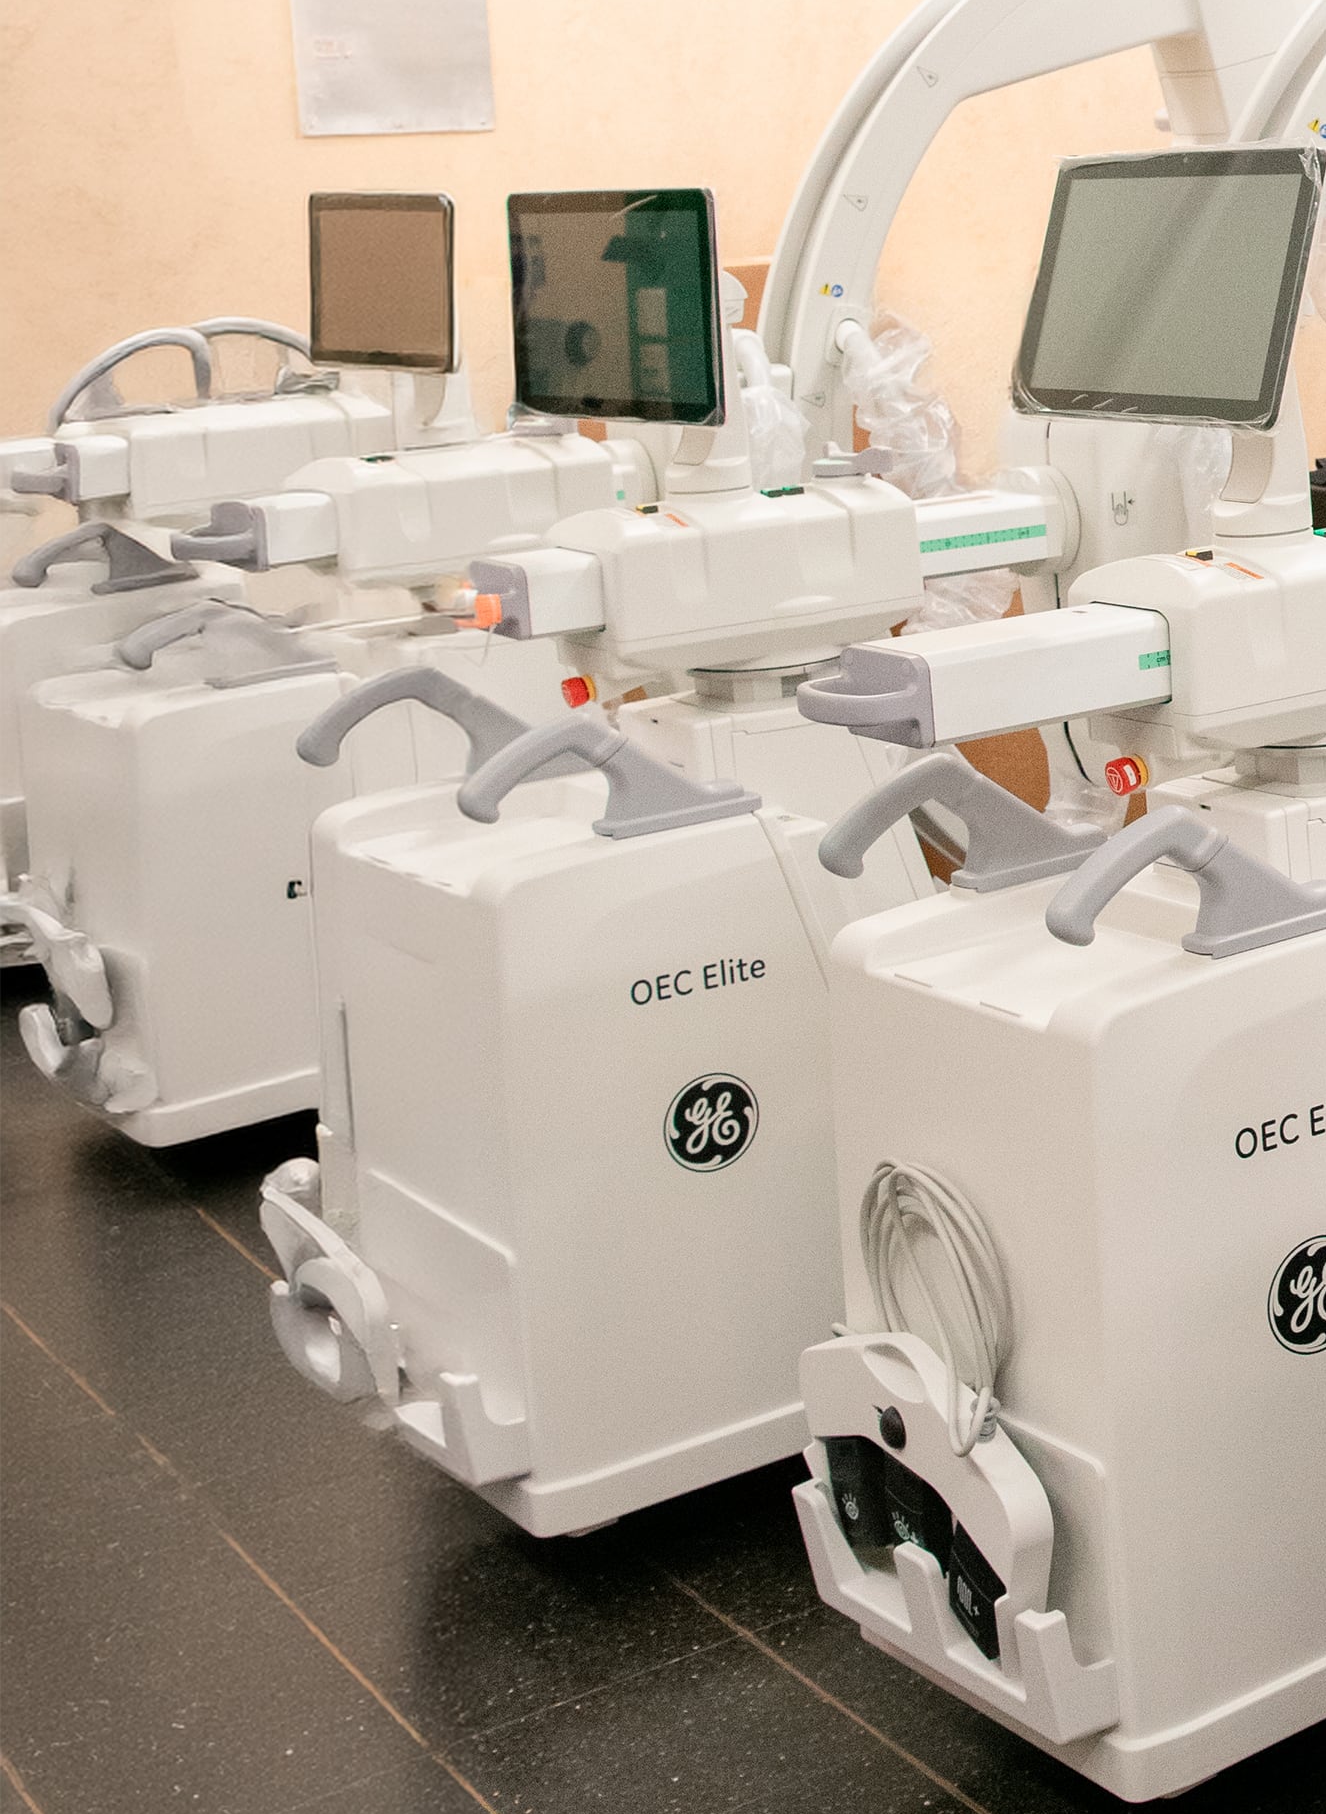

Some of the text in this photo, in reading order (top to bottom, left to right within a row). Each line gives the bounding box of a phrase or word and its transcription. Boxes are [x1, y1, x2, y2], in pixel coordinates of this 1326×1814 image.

[631, 958, 766, 1006] OEC Elite
[1235, 1113, 1300, 1159] OEC
